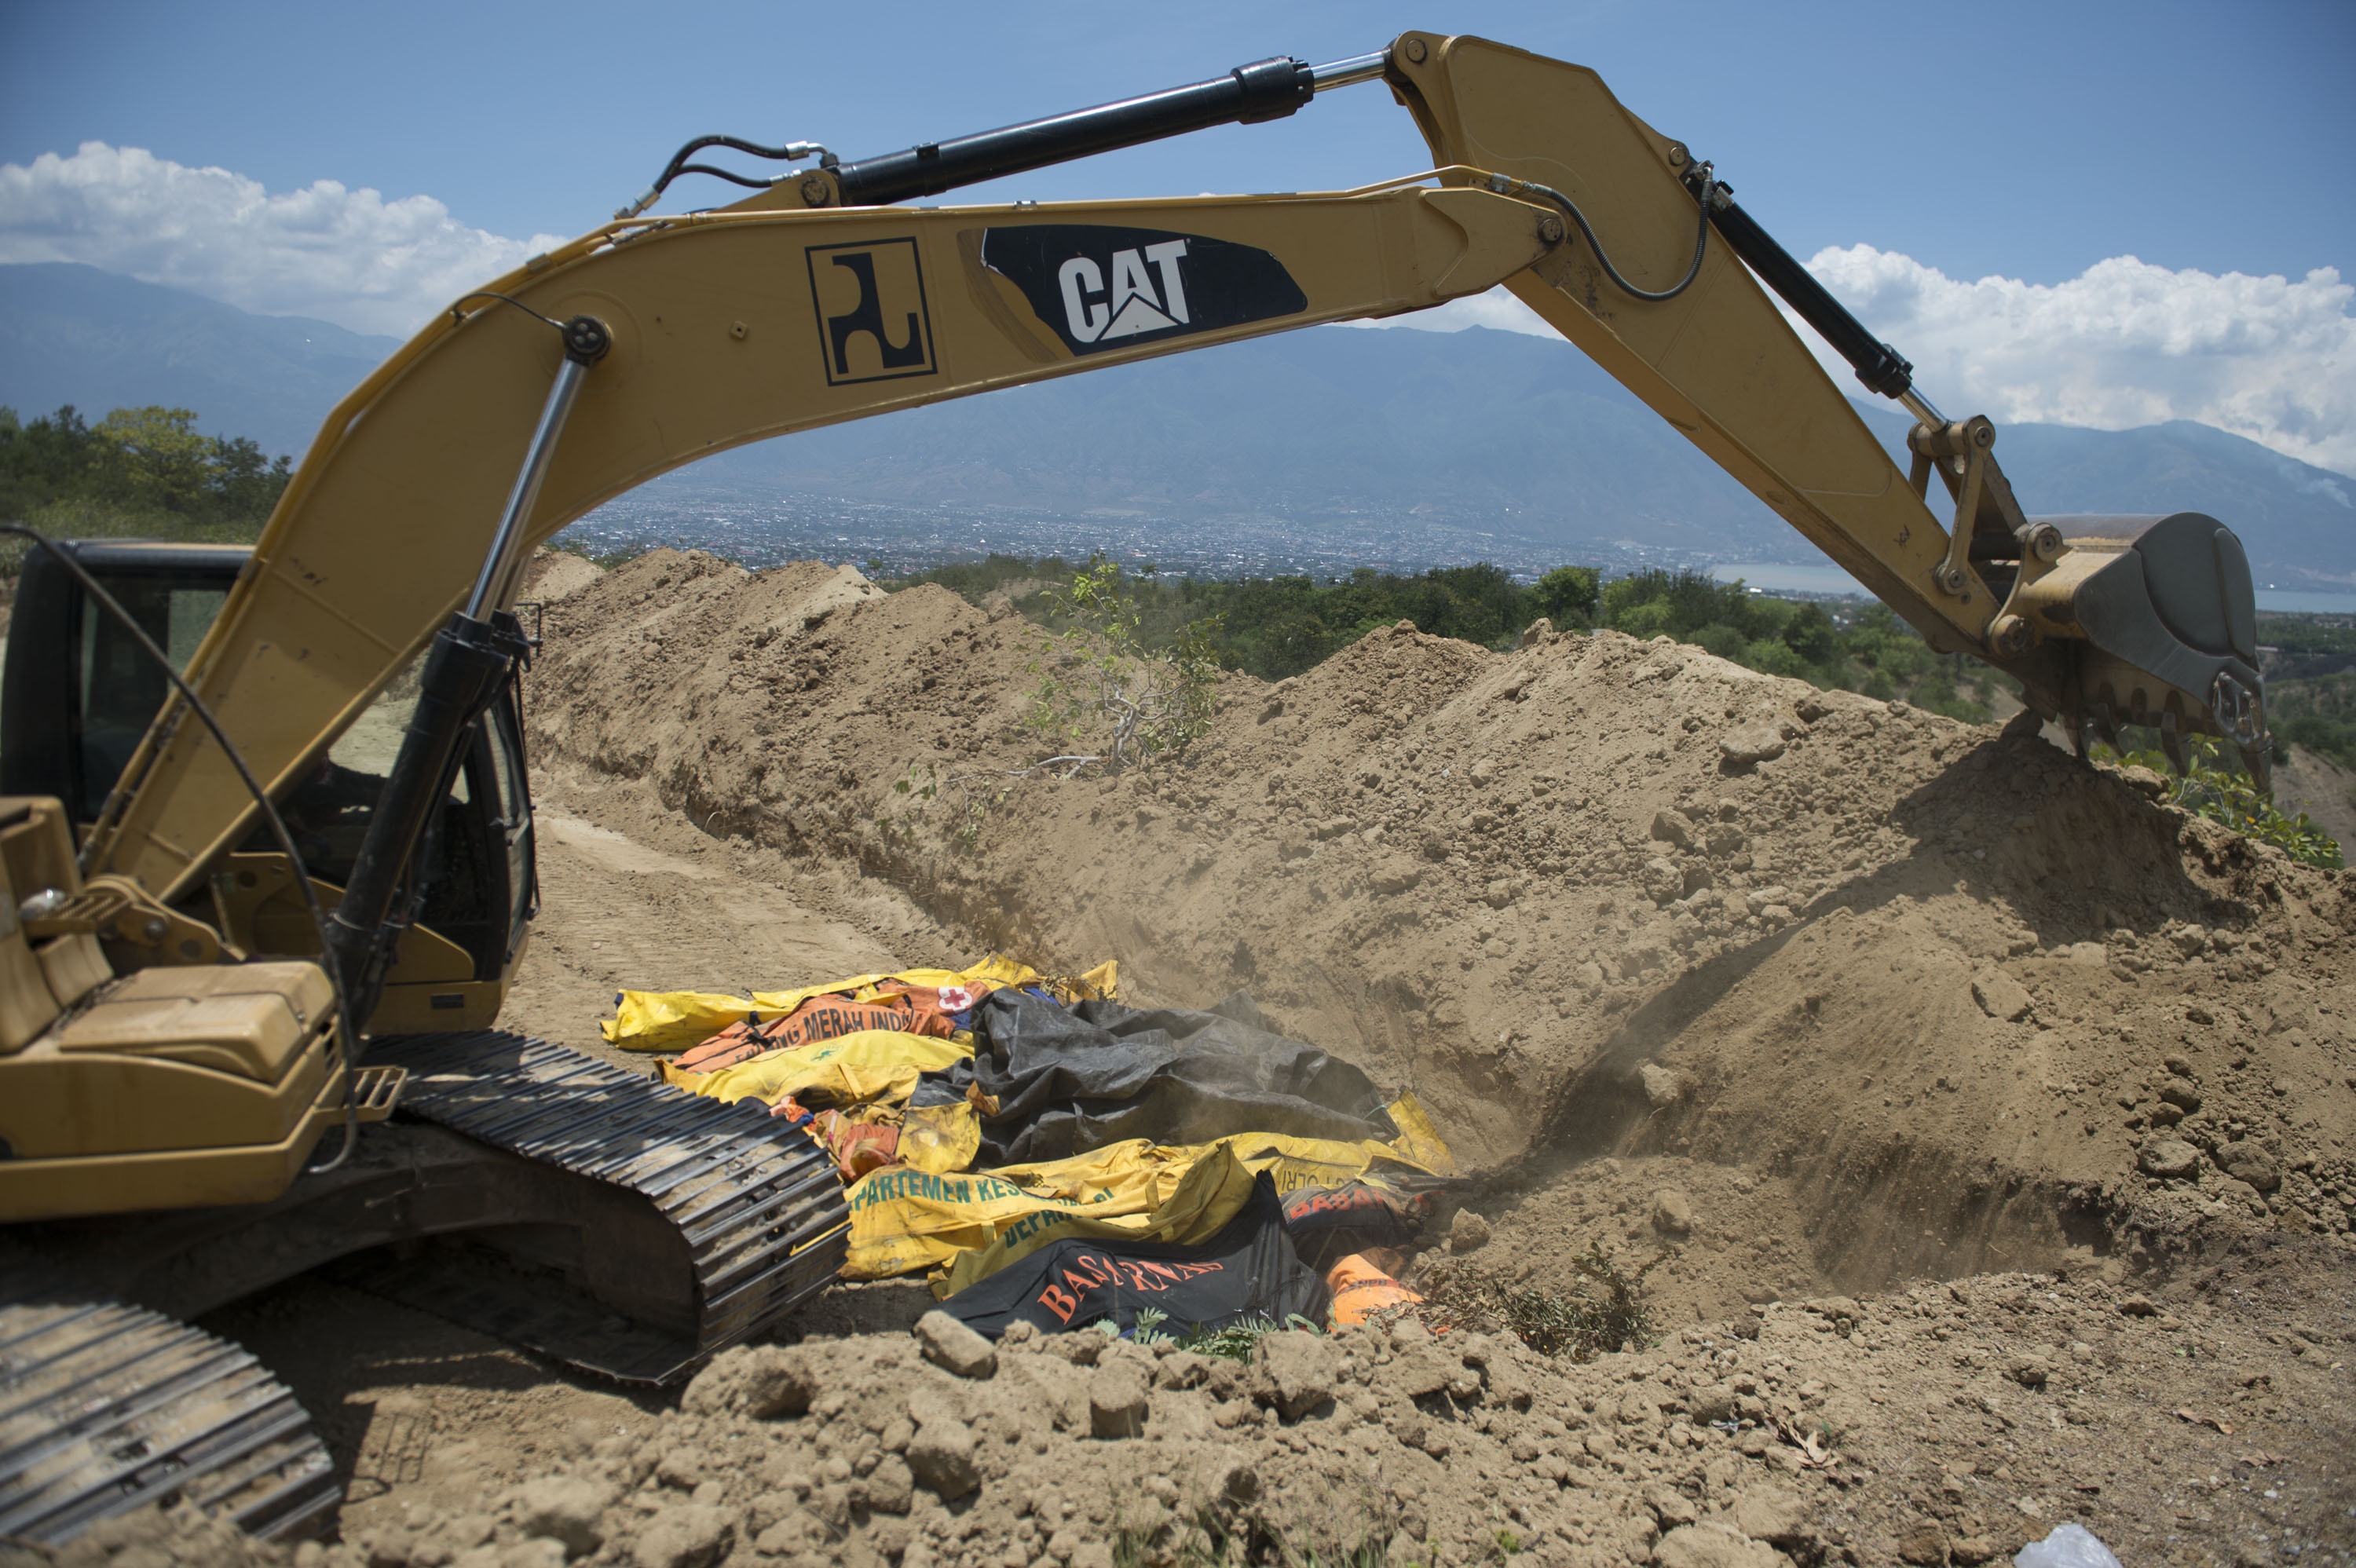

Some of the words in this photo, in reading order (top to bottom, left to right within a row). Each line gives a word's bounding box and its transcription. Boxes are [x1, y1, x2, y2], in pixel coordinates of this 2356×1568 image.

[1058, 239, 1189, 343] CAT
[803, 1008, 863, 1041] MERAH
[849, 1171, 971, 1212] PARTEMEN
